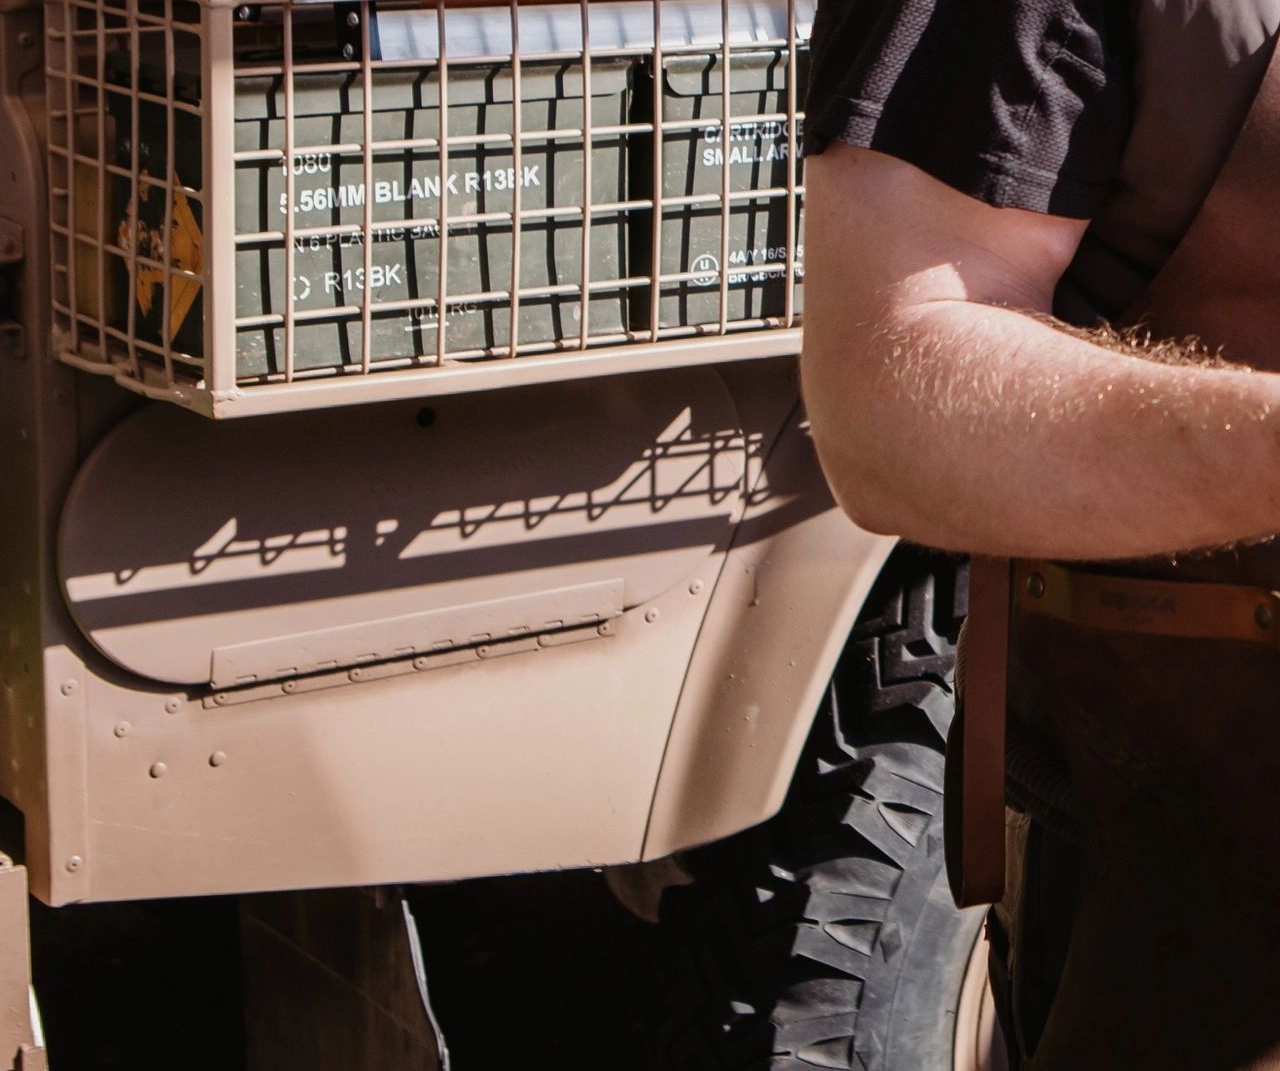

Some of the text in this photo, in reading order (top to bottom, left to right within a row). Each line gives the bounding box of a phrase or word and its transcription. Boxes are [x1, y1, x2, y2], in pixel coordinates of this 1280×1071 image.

[279, 153, 331, 177] 1080
[374, 174, 458, 204] BLANK
[464, 165, 541, 194] R13BK
[326, 226, 405, 250] PLATIC
[325, 263, 401, 294] R13BK
